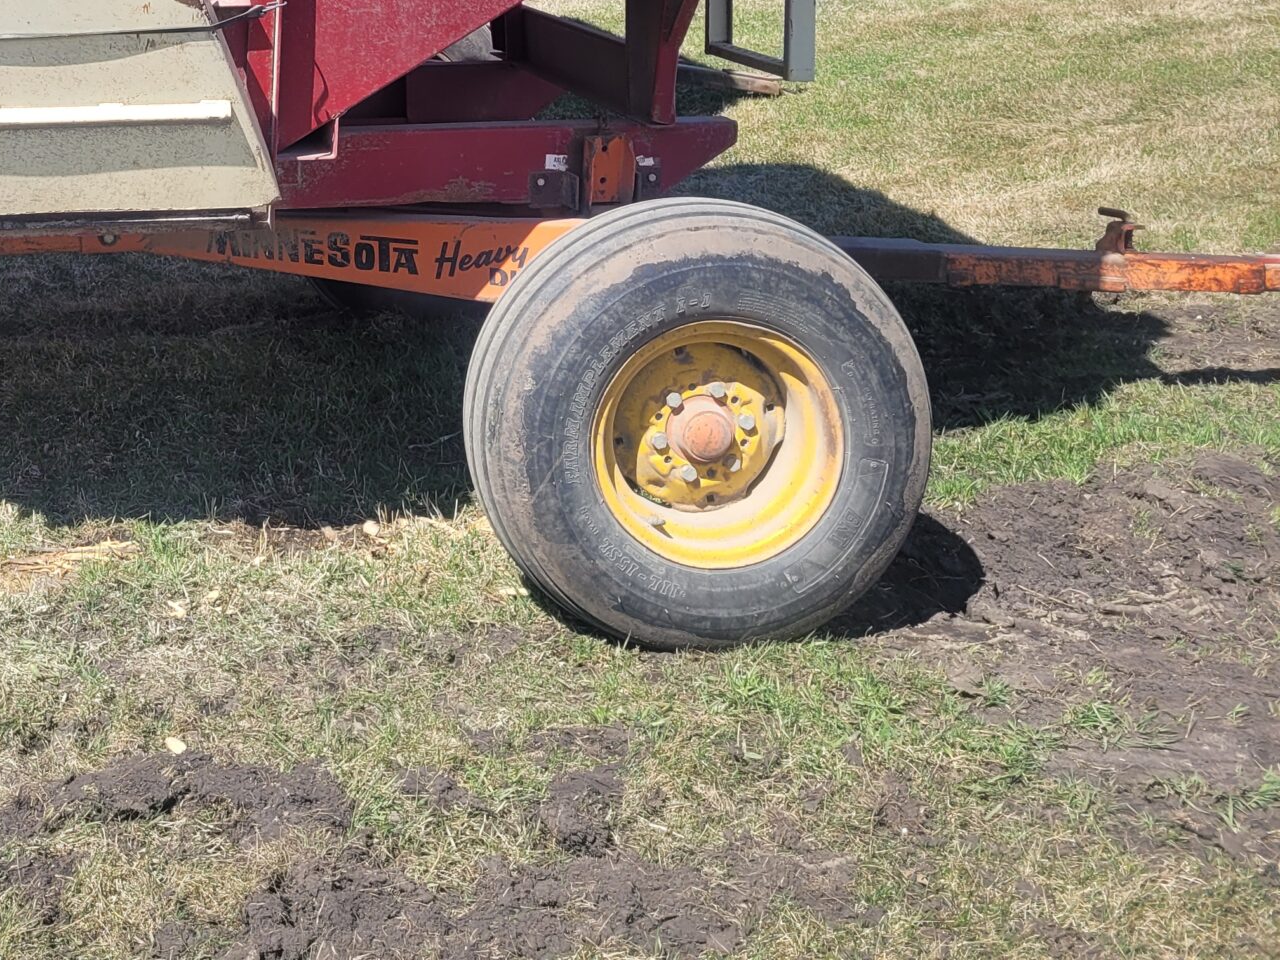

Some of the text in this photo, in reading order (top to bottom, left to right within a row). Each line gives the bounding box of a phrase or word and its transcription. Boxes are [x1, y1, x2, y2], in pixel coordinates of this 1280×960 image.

[434, 240, 529, 279] Heavy
[568, 303, 667, 417] IMPLEMENT
[563, 416, 582, 486] FARM
